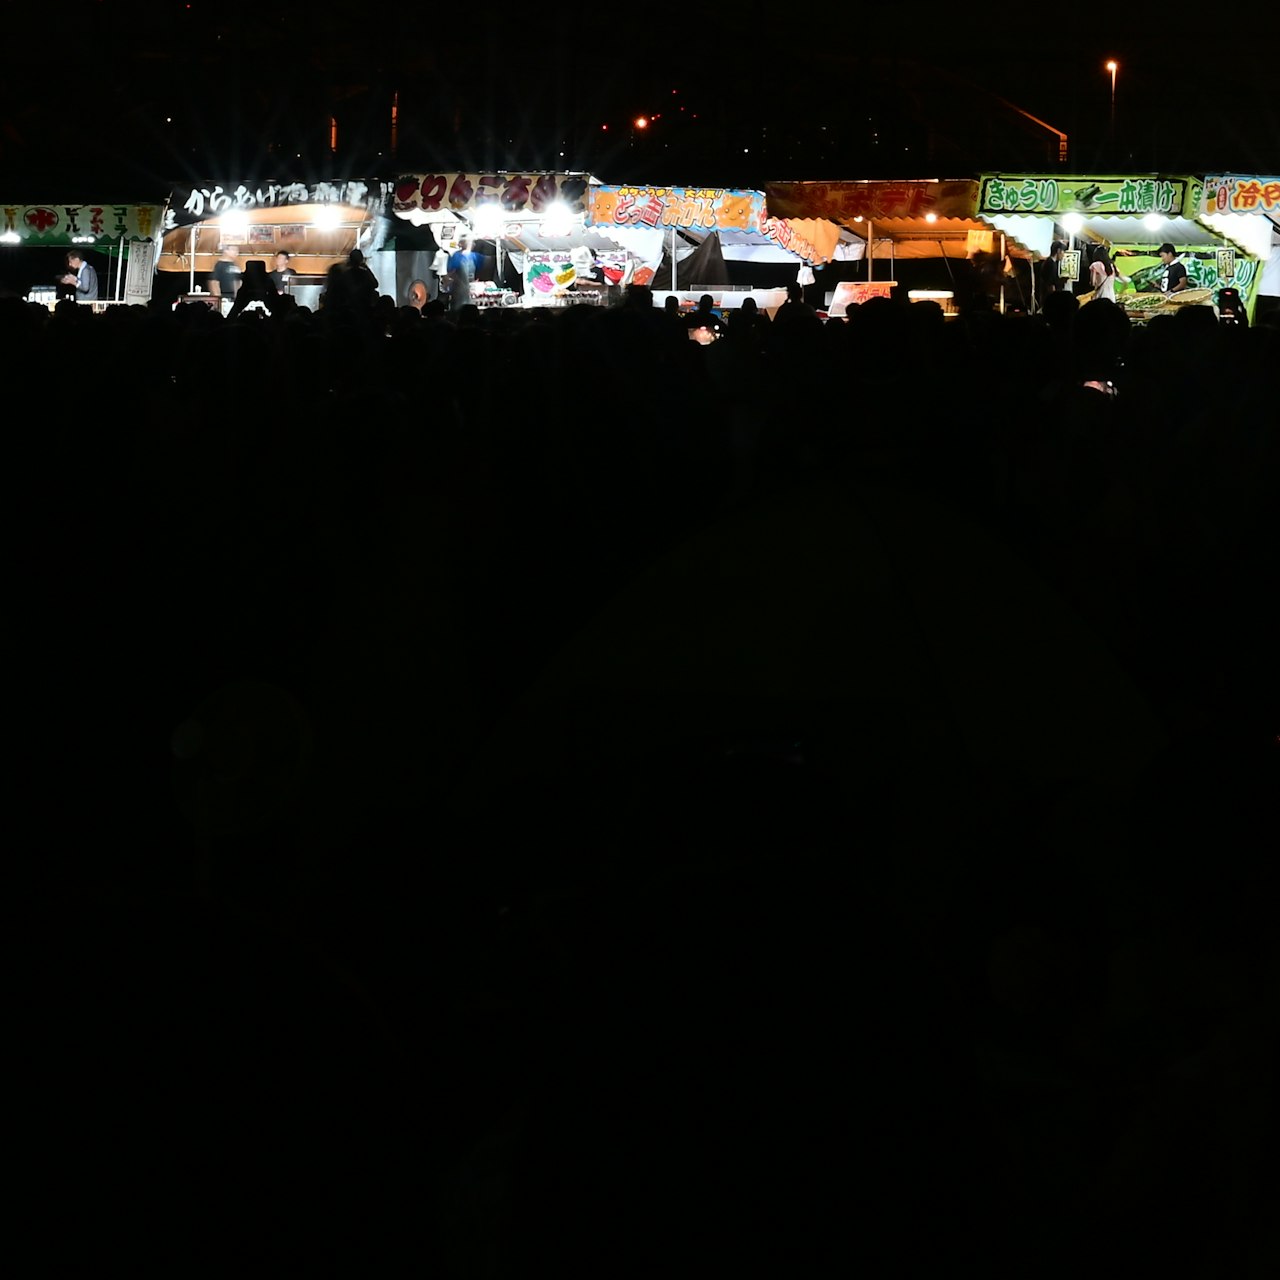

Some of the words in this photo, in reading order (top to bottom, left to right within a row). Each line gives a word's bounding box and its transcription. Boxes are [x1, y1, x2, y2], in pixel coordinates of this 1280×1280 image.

[987, 179, 1058, 210] きゅうり
[1094, 180, 1175, 213] 一本漬け
[65, 207, 82, 233] ビール
[113, 207, 128, 235] コーラ
